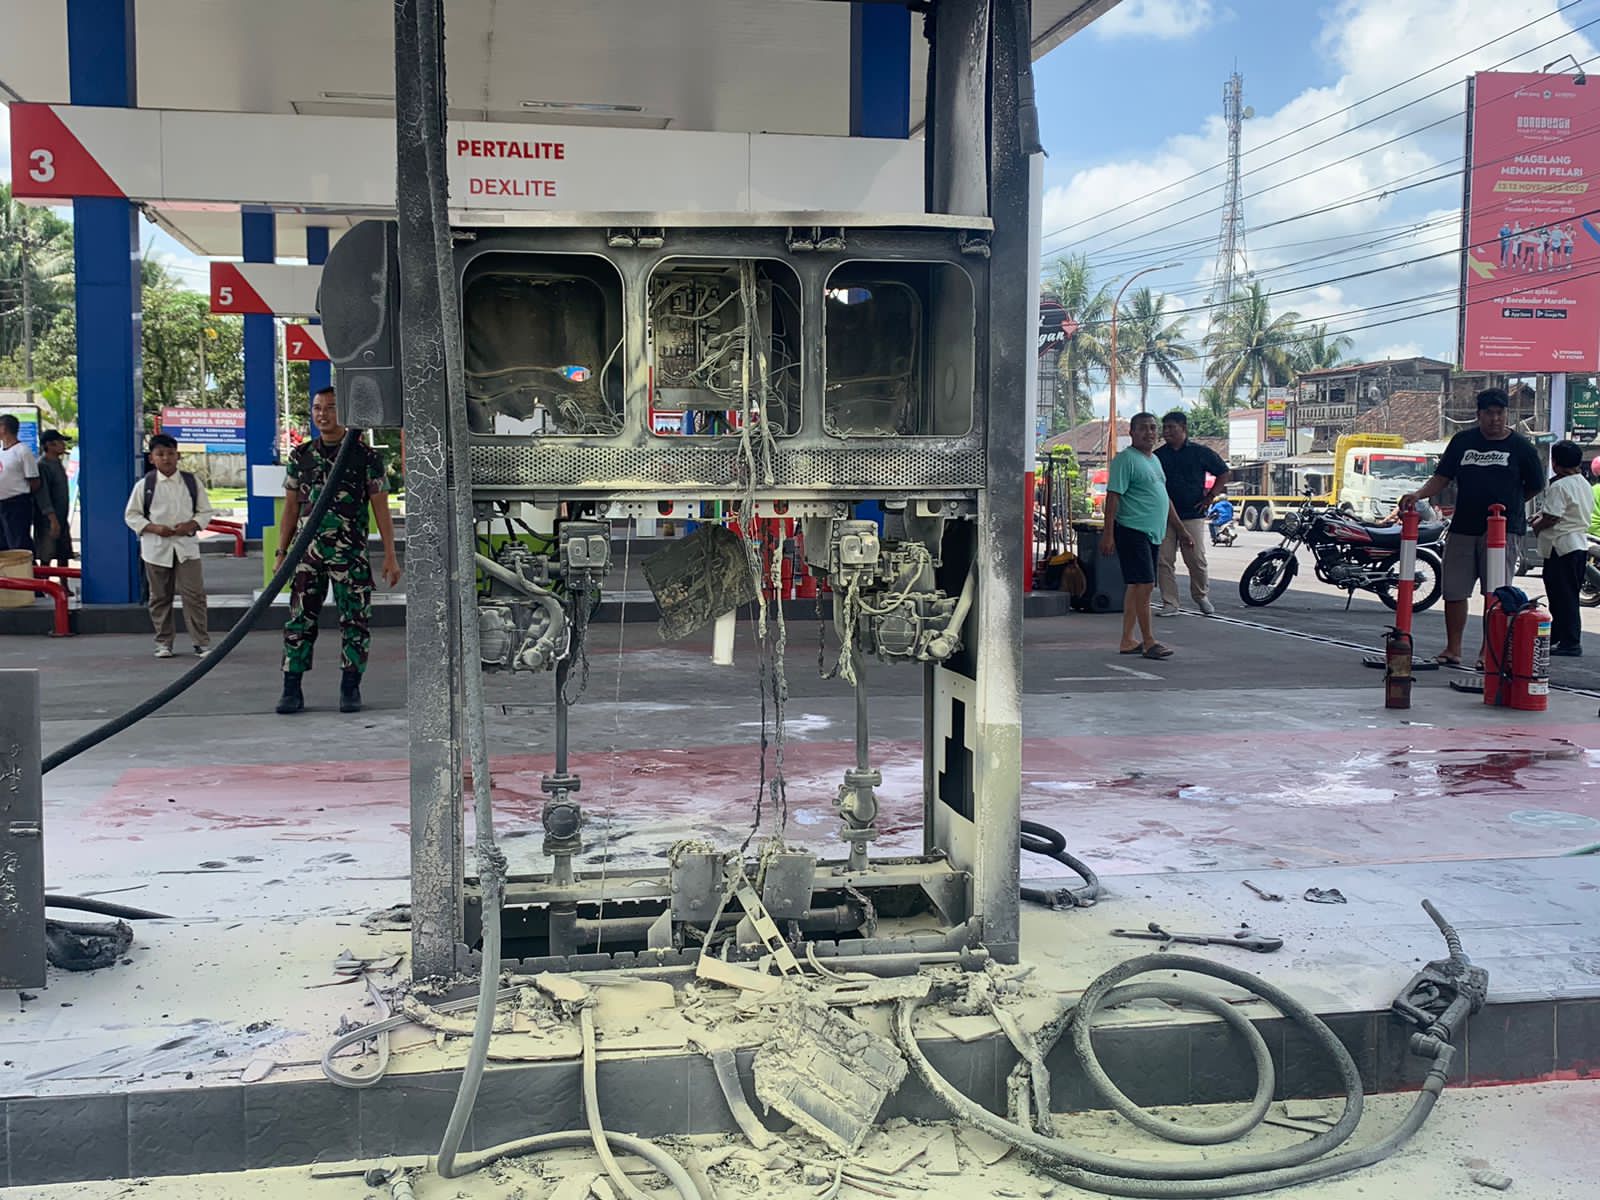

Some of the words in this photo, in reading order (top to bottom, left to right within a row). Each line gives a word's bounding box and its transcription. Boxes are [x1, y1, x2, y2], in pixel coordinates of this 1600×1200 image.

[457, 139, 565, 160] PERTALITE
[29, 149, 56, 182] 3
[1514, 155, 1572, 165] MAGELANG
[1501, 167, 1546, 175] MENANTI
[1549, 168, 1583, 177] PELARI
[469, 178, 557, 197] DEXLITE
[218, 287, 233, 305] 5
[291, 342, 303, 355] 7
[167, 410, 209, 418] DILARANG
